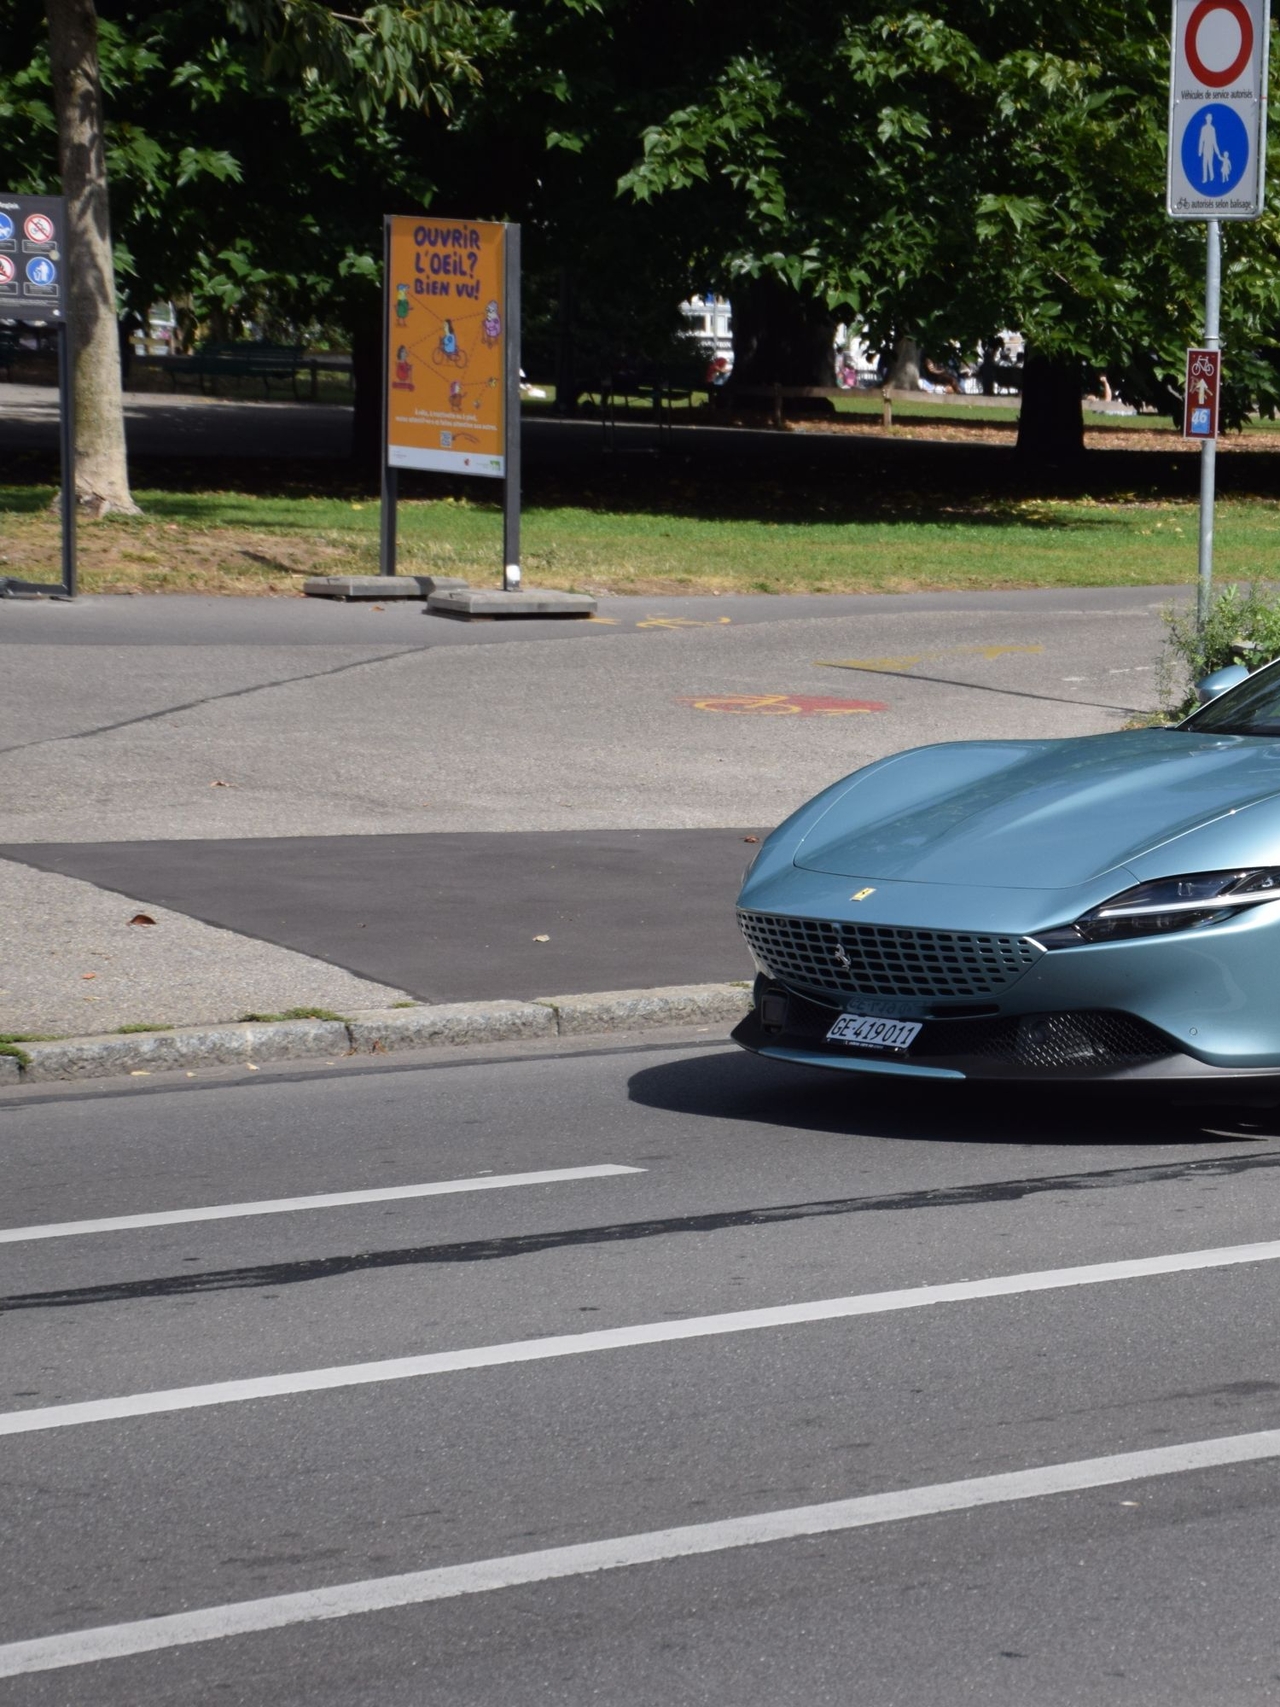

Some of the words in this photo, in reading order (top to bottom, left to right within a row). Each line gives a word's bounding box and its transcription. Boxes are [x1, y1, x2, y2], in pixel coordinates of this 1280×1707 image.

[1181, 90, 1204, 100] Véhicules
[1205, 90, 1211, 99] de
[1212, 90, 1229, 99] service
[1230, 90, 1252, 98] autorisés
[1191, 200, 1214, 208] autorisés
[1215, 200, 1229, 208] selon
[1230, 199, 1252, 210] balisage
[1192, 410, 1207, 424] 46
